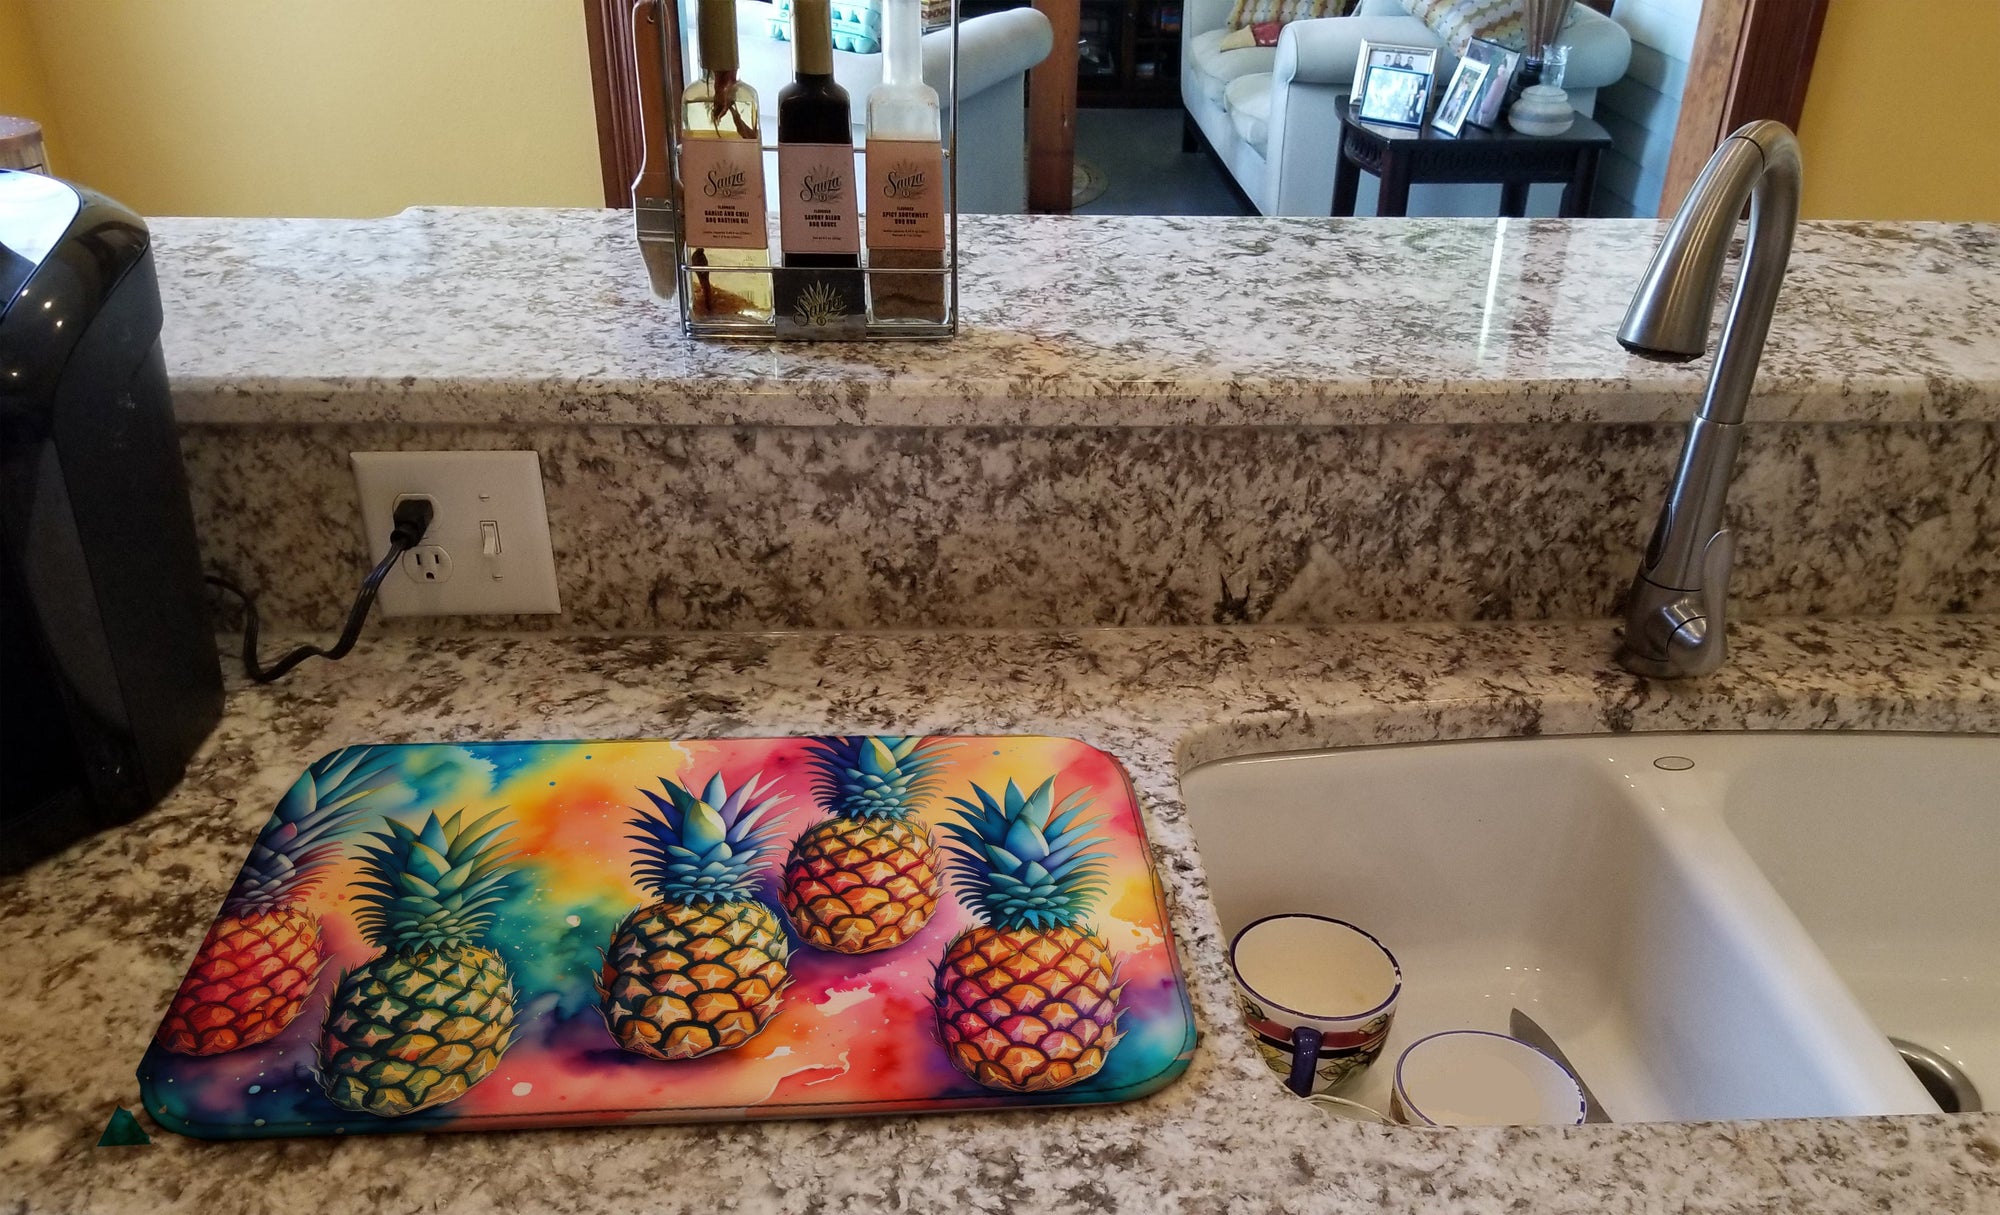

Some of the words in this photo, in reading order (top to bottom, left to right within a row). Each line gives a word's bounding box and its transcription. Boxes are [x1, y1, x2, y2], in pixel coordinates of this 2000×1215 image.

[704, 170, 745, 197] Sauza
[800, 175, 841, 202] Sauza
[883, 171, 924, 198] Sauza
